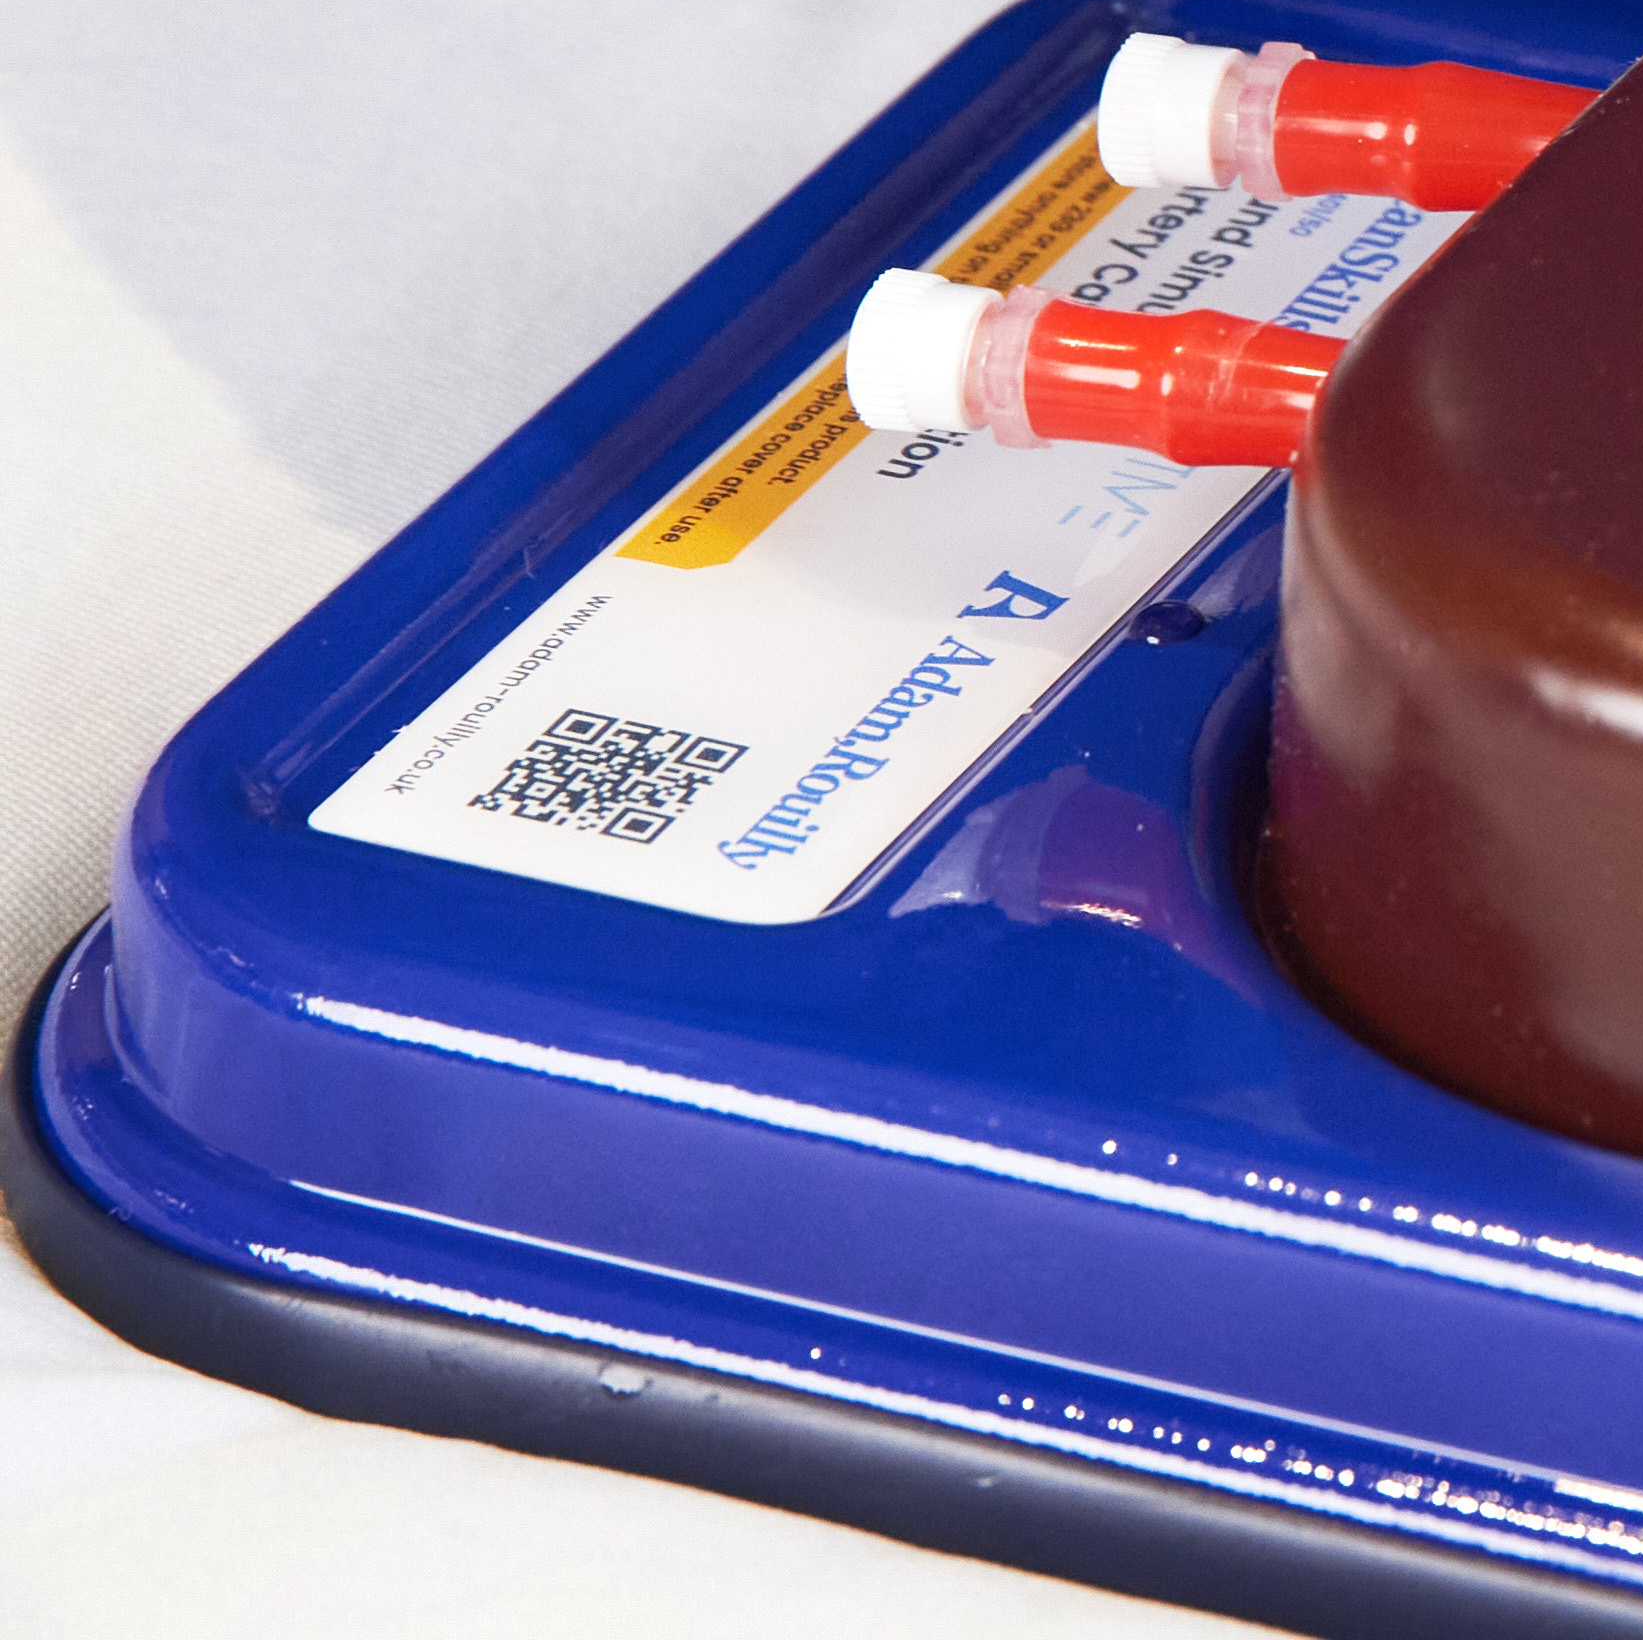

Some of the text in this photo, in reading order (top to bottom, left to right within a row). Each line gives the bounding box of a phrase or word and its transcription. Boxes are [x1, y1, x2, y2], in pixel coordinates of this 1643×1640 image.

[1070, 264, 1138, 301] Ca
[1135, 250, 1233, 319] Simu
[1274, 199, 1425, 331] anSkills
[789, 378, 848, 432] eplace
[736, 434, 791, 474] cover
[767, 423, 847, 484] product.
[694, 476, 742, 512] after
[655, 515, 701, 543] use.
[385, 596, 611, 793] www.adam-rouilly.co.uk
[718, 635, 995, 869] Adam,Rouilly
